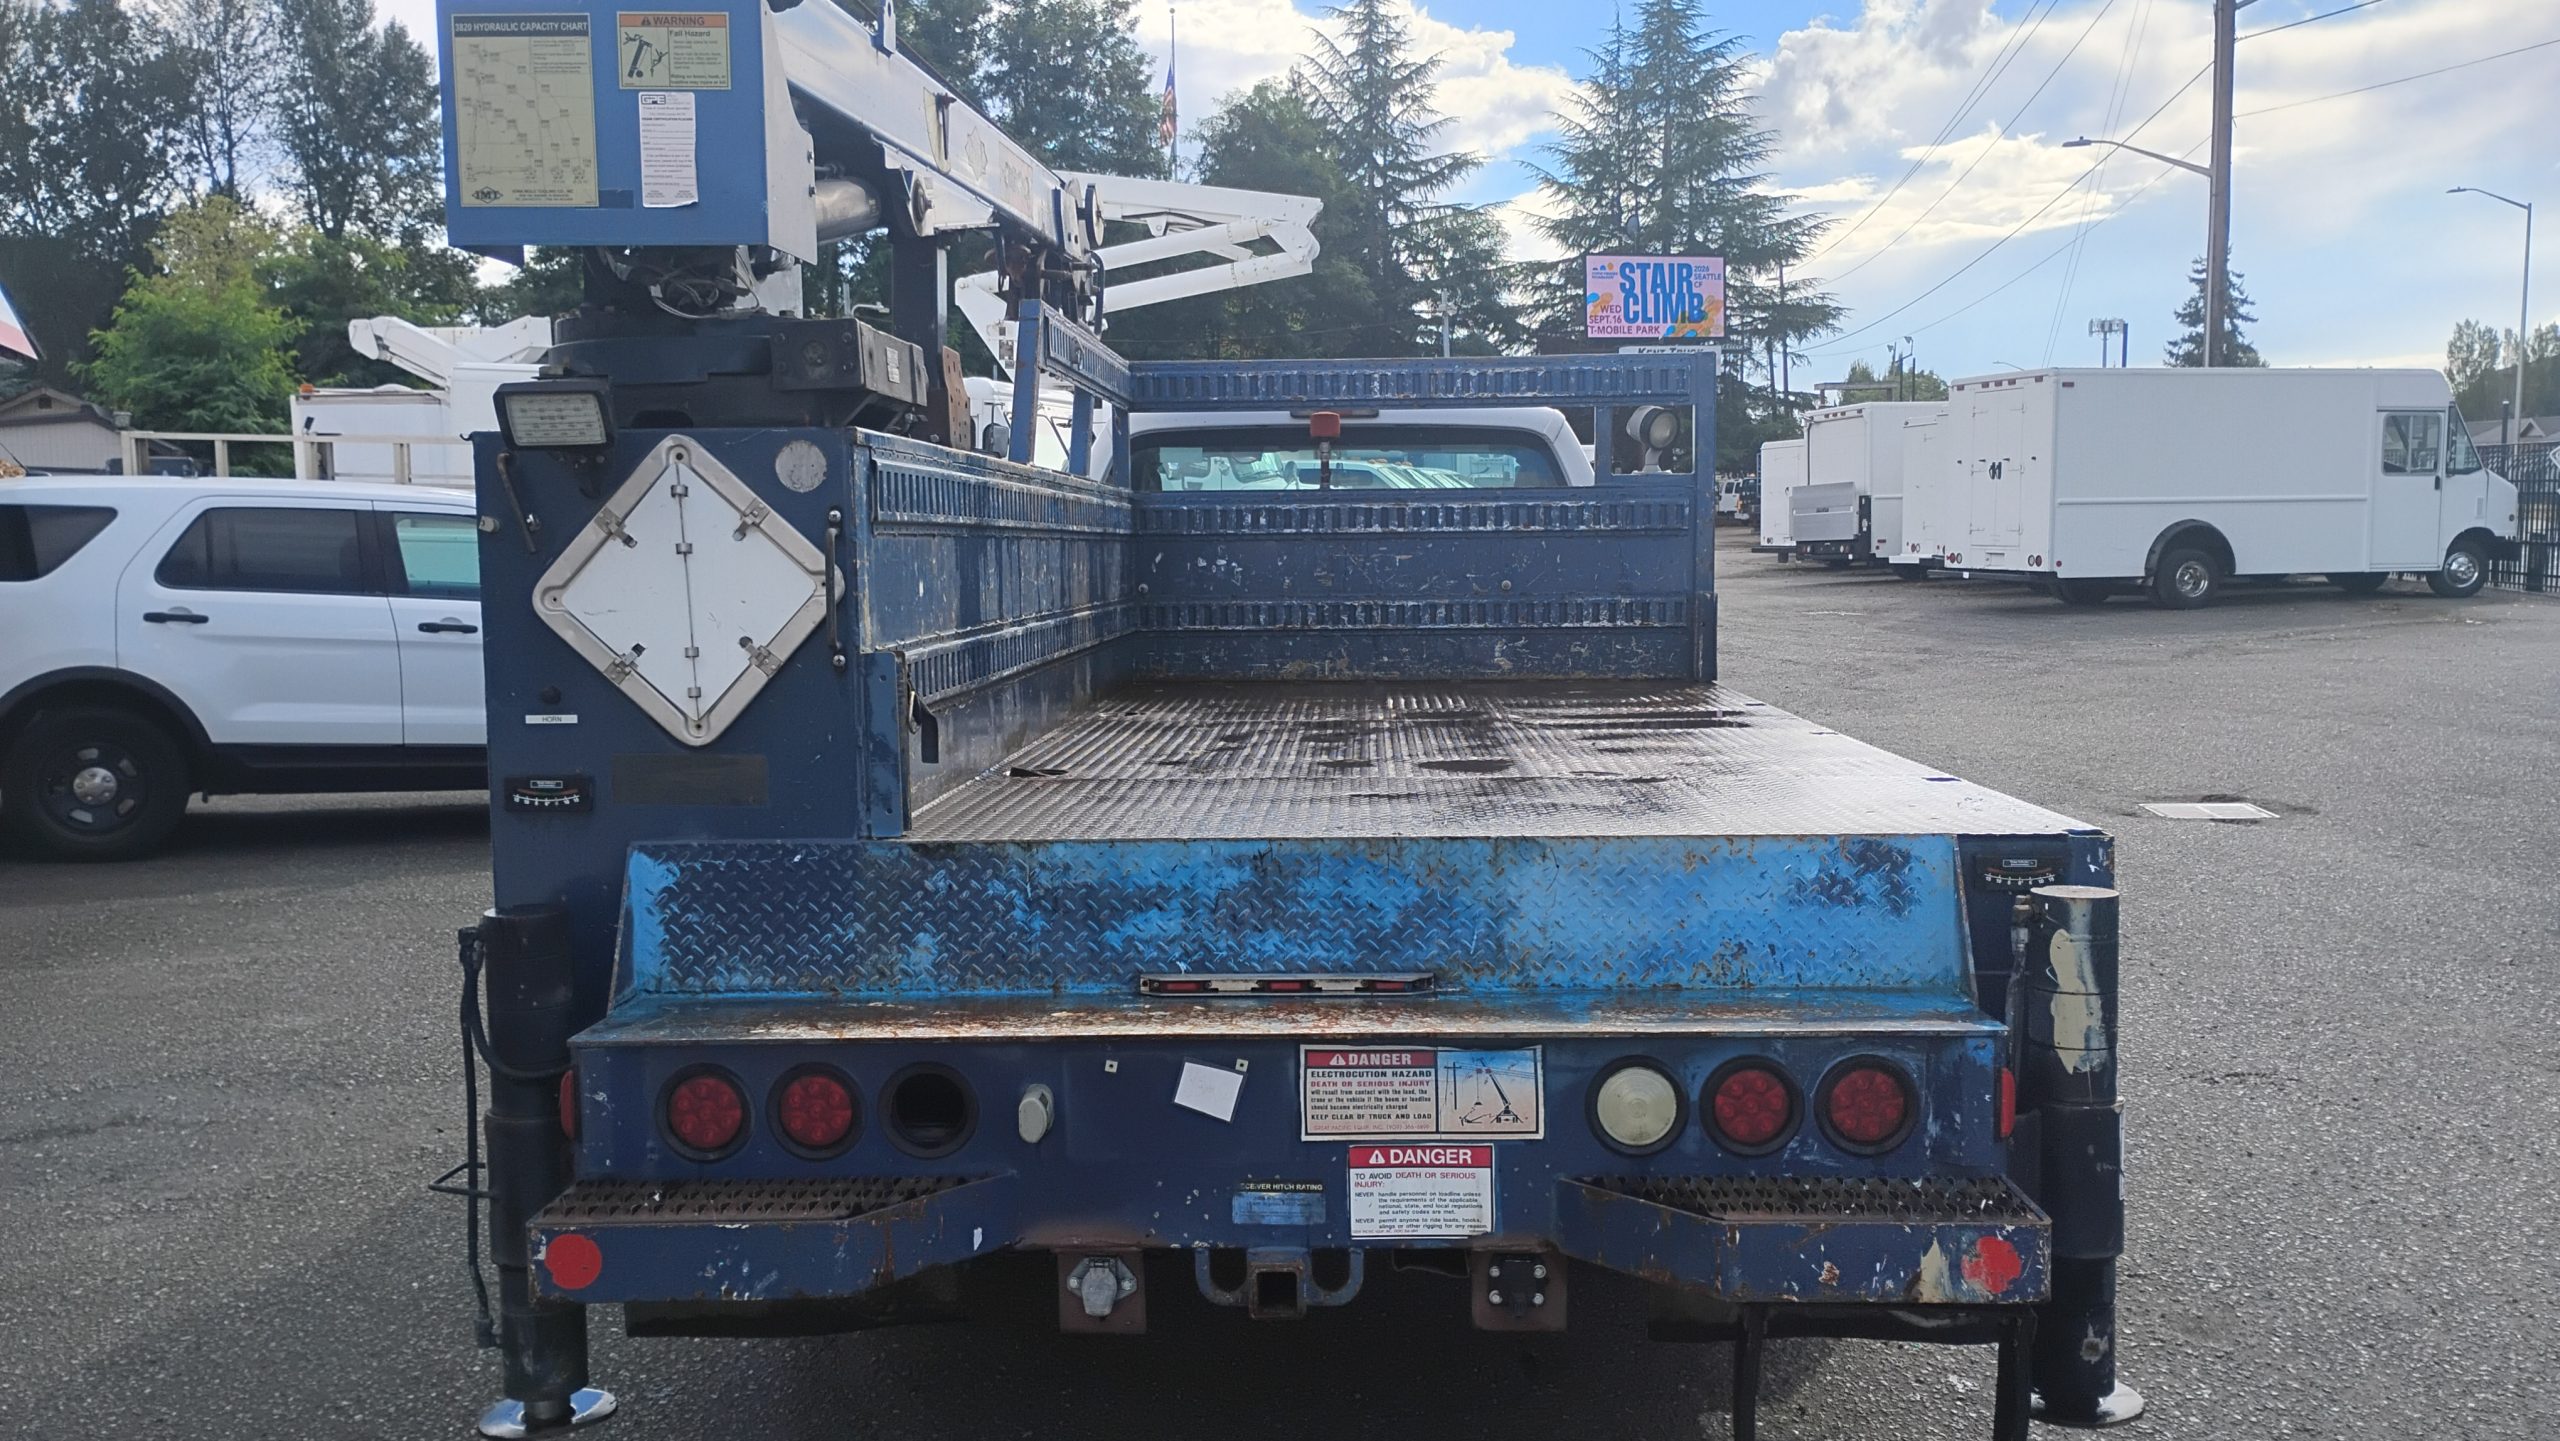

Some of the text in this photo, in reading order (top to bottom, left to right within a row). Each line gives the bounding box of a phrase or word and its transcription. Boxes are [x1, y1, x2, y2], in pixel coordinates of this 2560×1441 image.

[653, 16, 705, 26] WARNING
[473, 22, 518, 32] HYDRAULIC
[520, 22, 559, 31] CAPACITY
[560, 21, 588, 31] CHART
[1619, 261, 1693, 296] STAIR
[1693, 273, 1722, 281] SEATTLE
[1600, 304, 1622, 314] WED
[1623, 292, 1706, 324] CLIMB
[1589, 314, 1622, 324] SEPT. 16
[1590, 325, 1660, 335] T-MOBILE PARK
[1348, 1053, 1412, 1066] DANGER
[1311, 1070, 1432, 1078] ELECTROCUTION HAZARD
[1390, 1149, 1472, 1164] DANGER
[1368, 1172, 1392, 1180] AVOID
[1354, 1180, 1384, 1188] INJURY:
